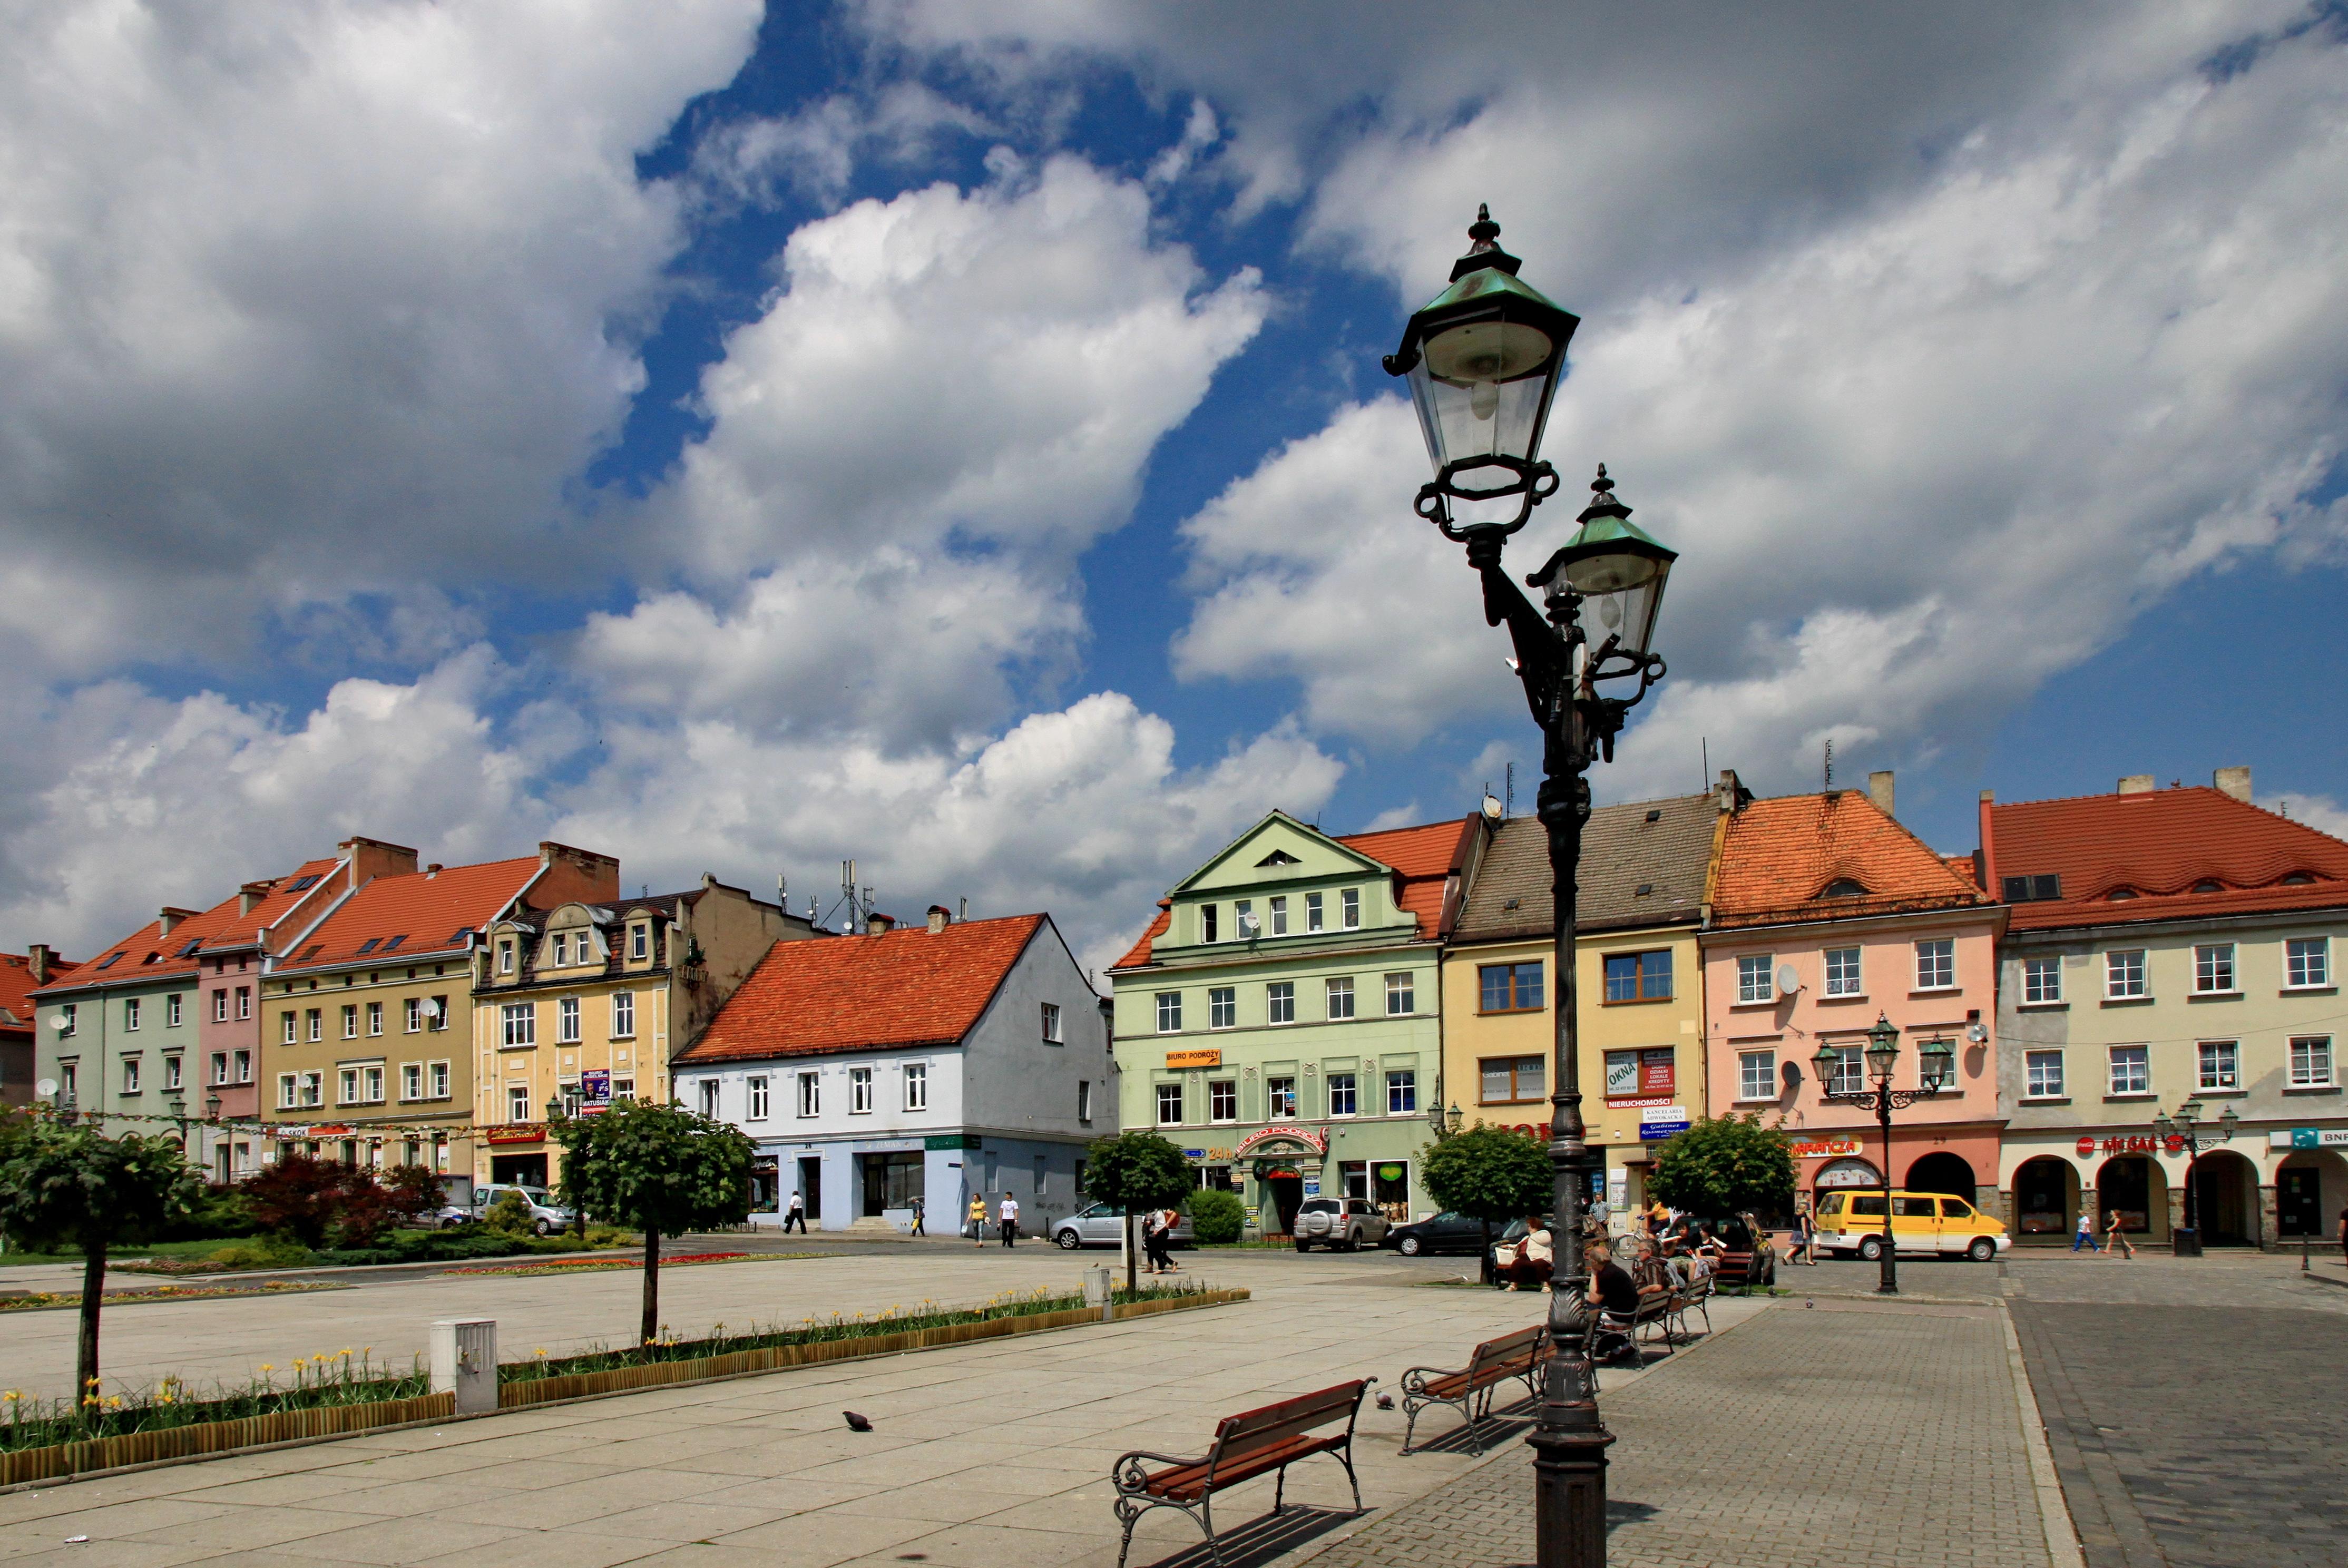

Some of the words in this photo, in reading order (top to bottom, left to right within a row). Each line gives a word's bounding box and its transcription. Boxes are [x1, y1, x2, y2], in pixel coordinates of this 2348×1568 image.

[1189, 1050, 1218, 1059] PODRÓŻY
[1609, 1062, 1636, 1085] OKNA
[1609, 1099, 1670, 1108] NIERUCHOMOŚCI
[1237, 1129, 1269, 1153] BIURO
[1209, 1148, 1224, 1160] 24
